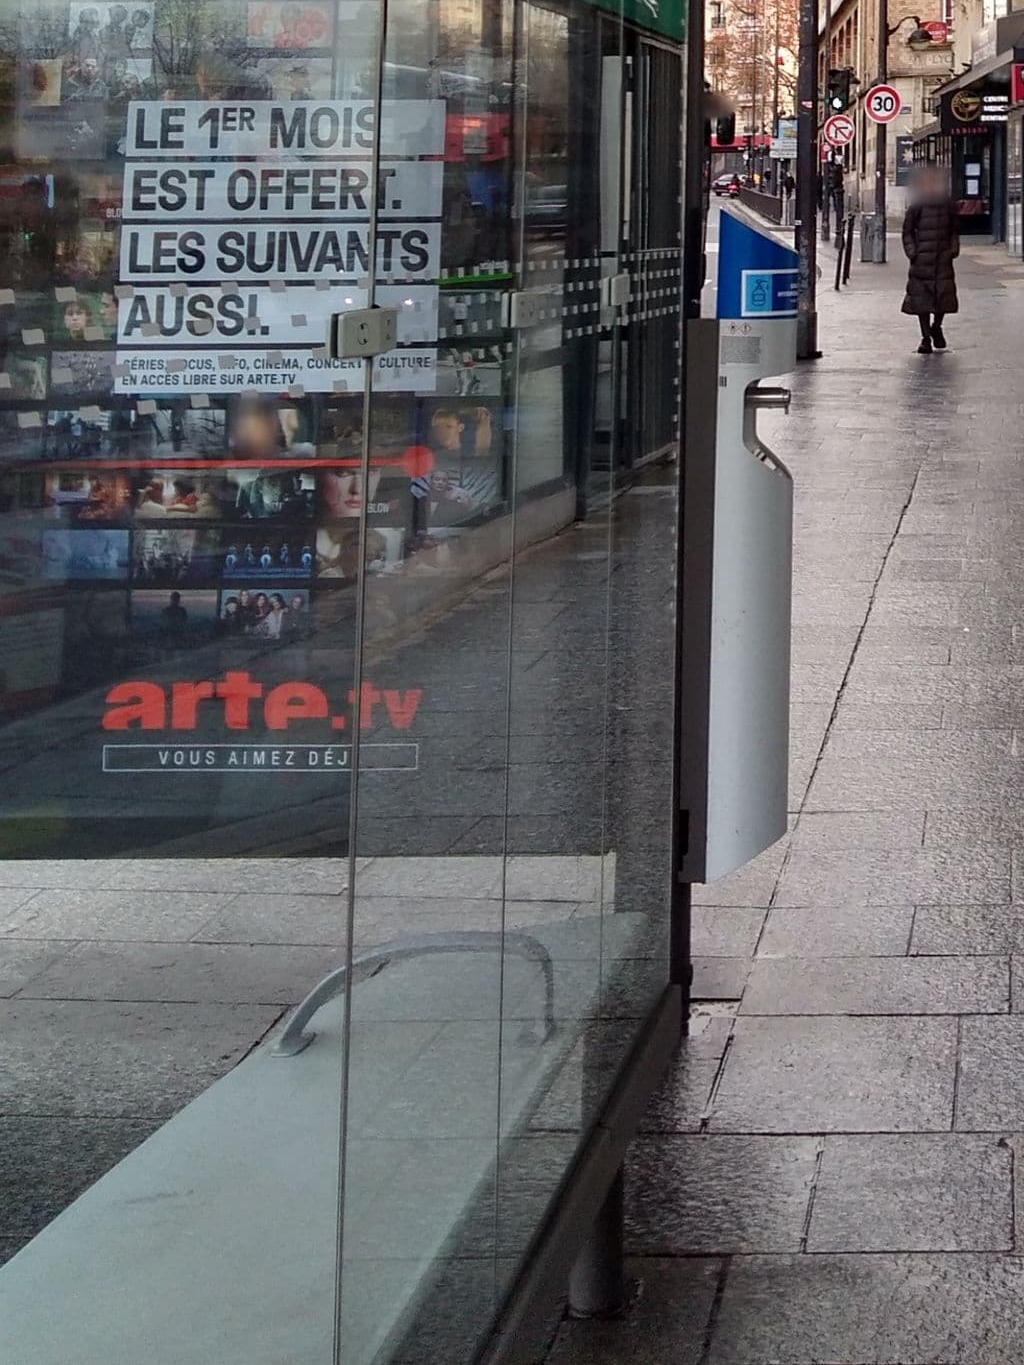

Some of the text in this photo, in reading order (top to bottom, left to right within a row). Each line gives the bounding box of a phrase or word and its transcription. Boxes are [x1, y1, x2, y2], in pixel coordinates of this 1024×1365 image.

[872, 96, 894, 112] 30
[134, 106, 375, 149] LE 1ER MOIS
[131, 168, 402, 212] EST OFFERT.
[128, 229, 430, 274] LES SUIVANTS
[122, 374, 138, 386] EN
[183, 373, 217, 386] LIBRE
[219, 372, 244, 385] SUR
[246, 371, 296, 385] ARTE.TV
[102, 671, 423, 730] arte.tv
[158, 747, 349, 766] VOUS AIMEZ DÉJ
